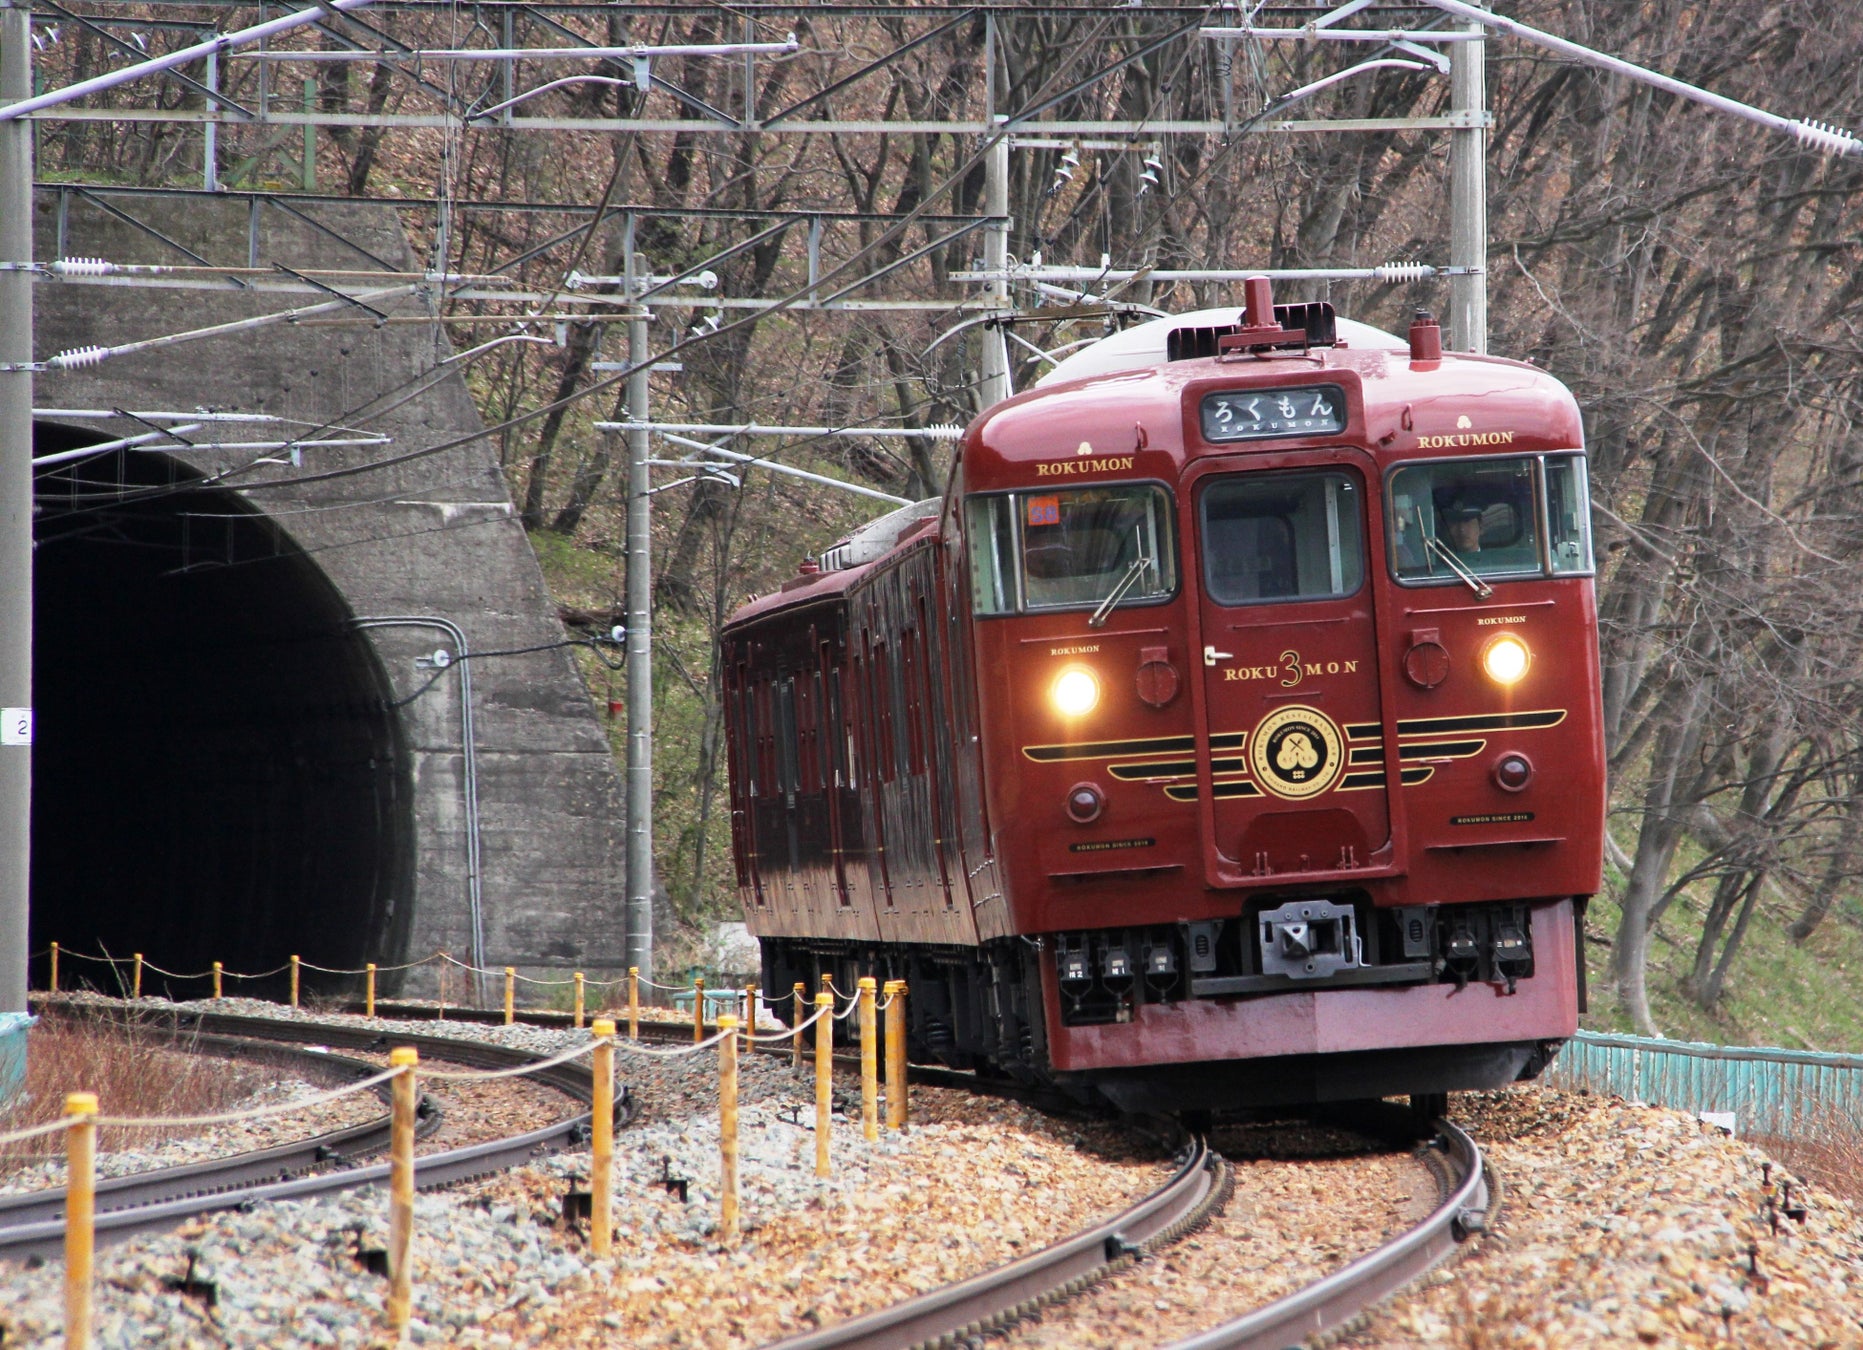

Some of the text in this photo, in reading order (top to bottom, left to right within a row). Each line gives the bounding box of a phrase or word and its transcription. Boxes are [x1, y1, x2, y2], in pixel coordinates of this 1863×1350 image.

[1214, 393, 1333, 423] ろくもん
[1220, 418, 1329, 433] ROKUMON
[1417, 431, 1515, 449] ROKUMON
[1036, 457, 1134, 476] ROKUMON
[1476, 615, 1526, 625] ROKUMON
[1050, 644, 1100, 656] ROKUMON
[18, 719, 28, 735] 2
[1457, 816, 1490, 824] ROKUMON
